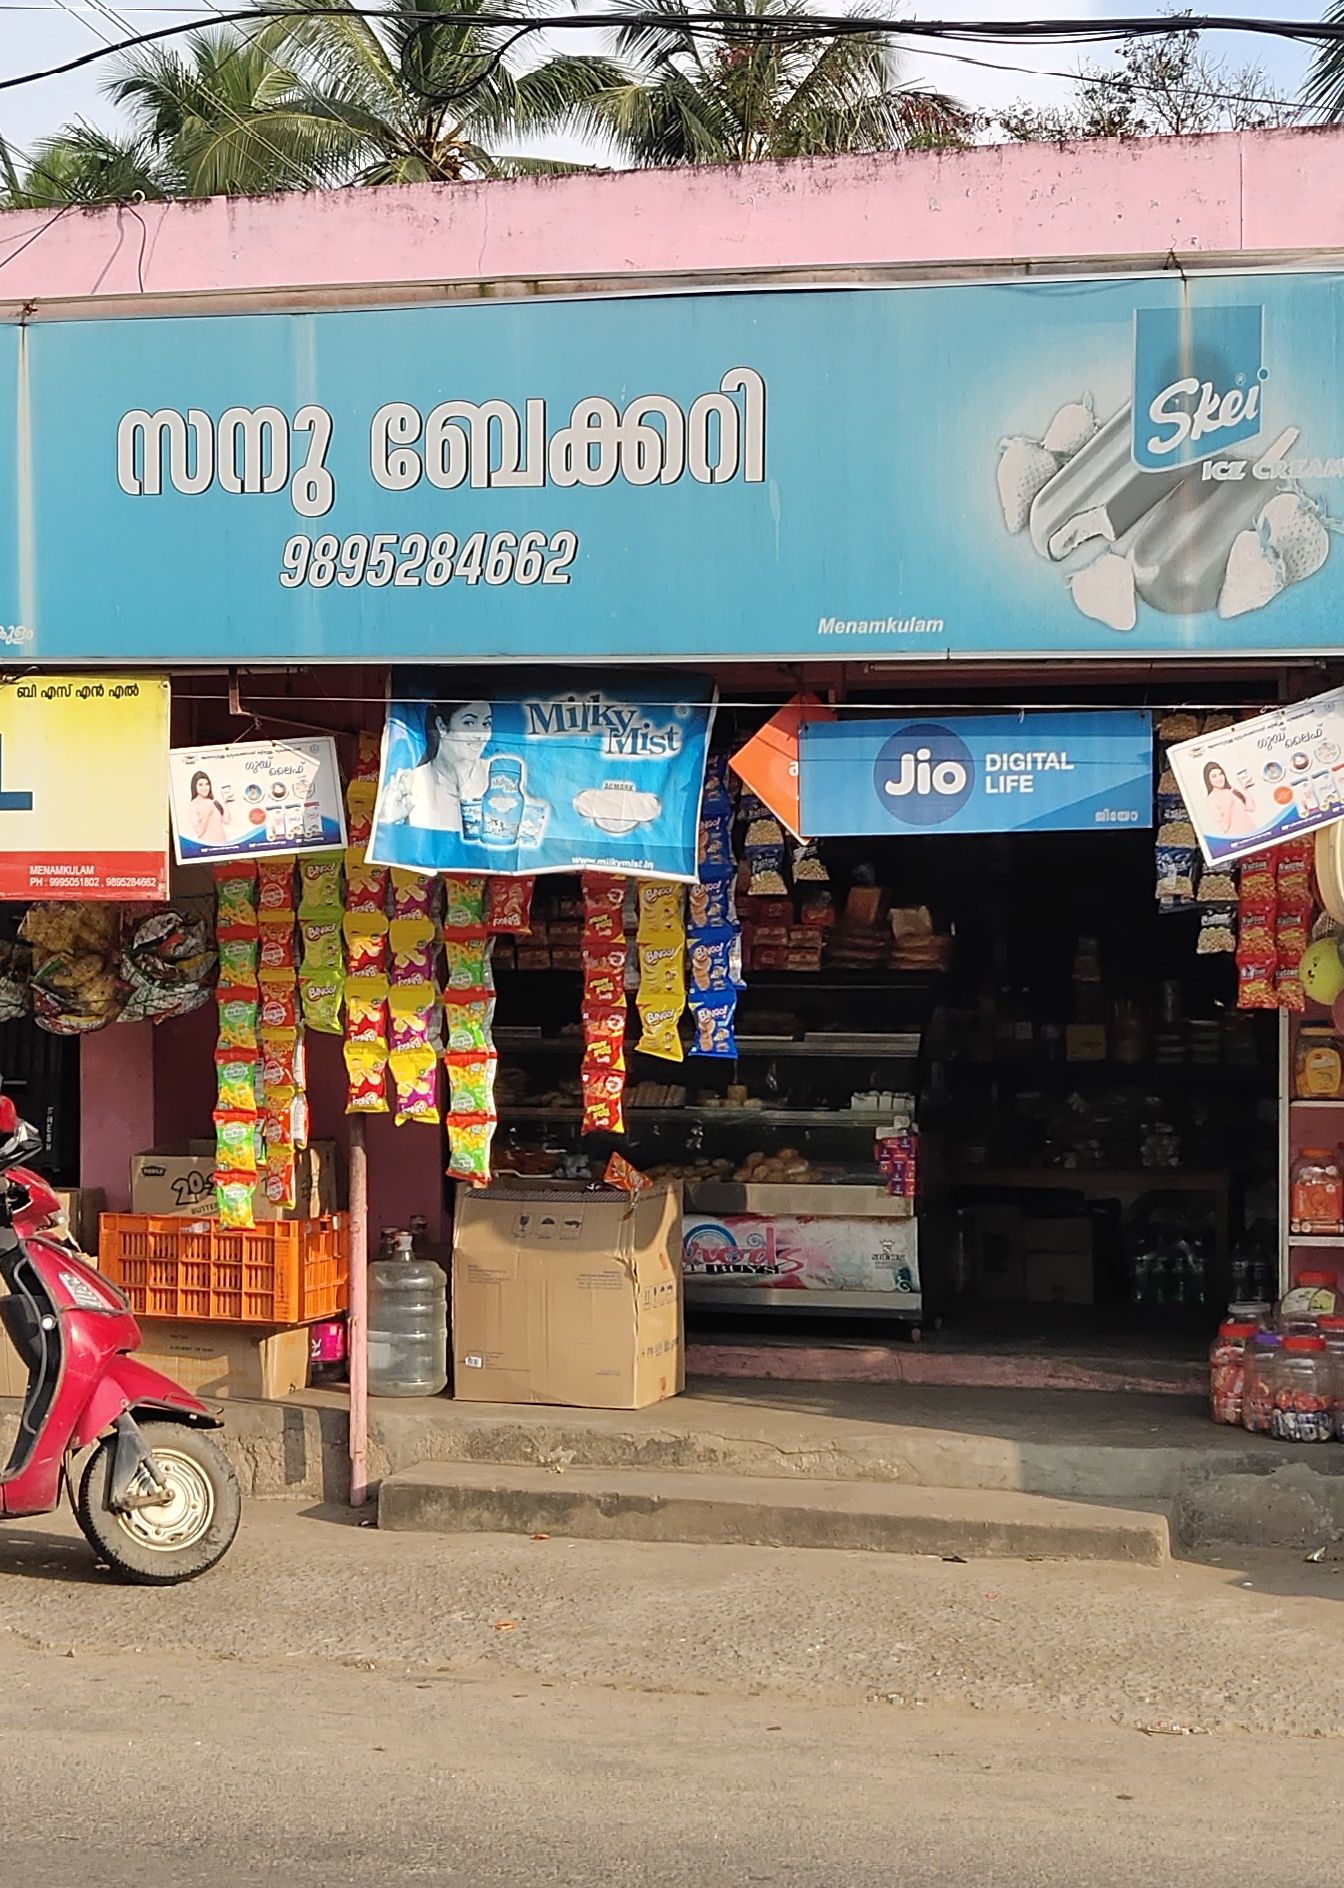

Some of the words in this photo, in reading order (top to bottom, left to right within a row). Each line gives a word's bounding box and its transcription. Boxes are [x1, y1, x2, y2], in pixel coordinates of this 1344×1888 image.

[1146, 366, 1271, 454] Skei
[116, 404, 336, 519] സനു
[368, 366, 768, 491] ബേക്കറി
[278, 530, 579, 589] 9895284662
[818, 616, 945, 636] Menamkulam
[16, 683, 37, 698] ബി
[40, 684, 73, 700] എസ്
[527, 694, 639, 735] Milky
[605, 723, 681, 756] Mist
[885, 748, 967, 796] Jio
[985, 752, 1074, 772] DIGITAL
[985, 775, 1034, 794] LIFE
[29, 865, 95, 875] MENAMKULAM
[29, 877, 43, 887] PH
[191, 1201, 218, 1215] BUTTE
